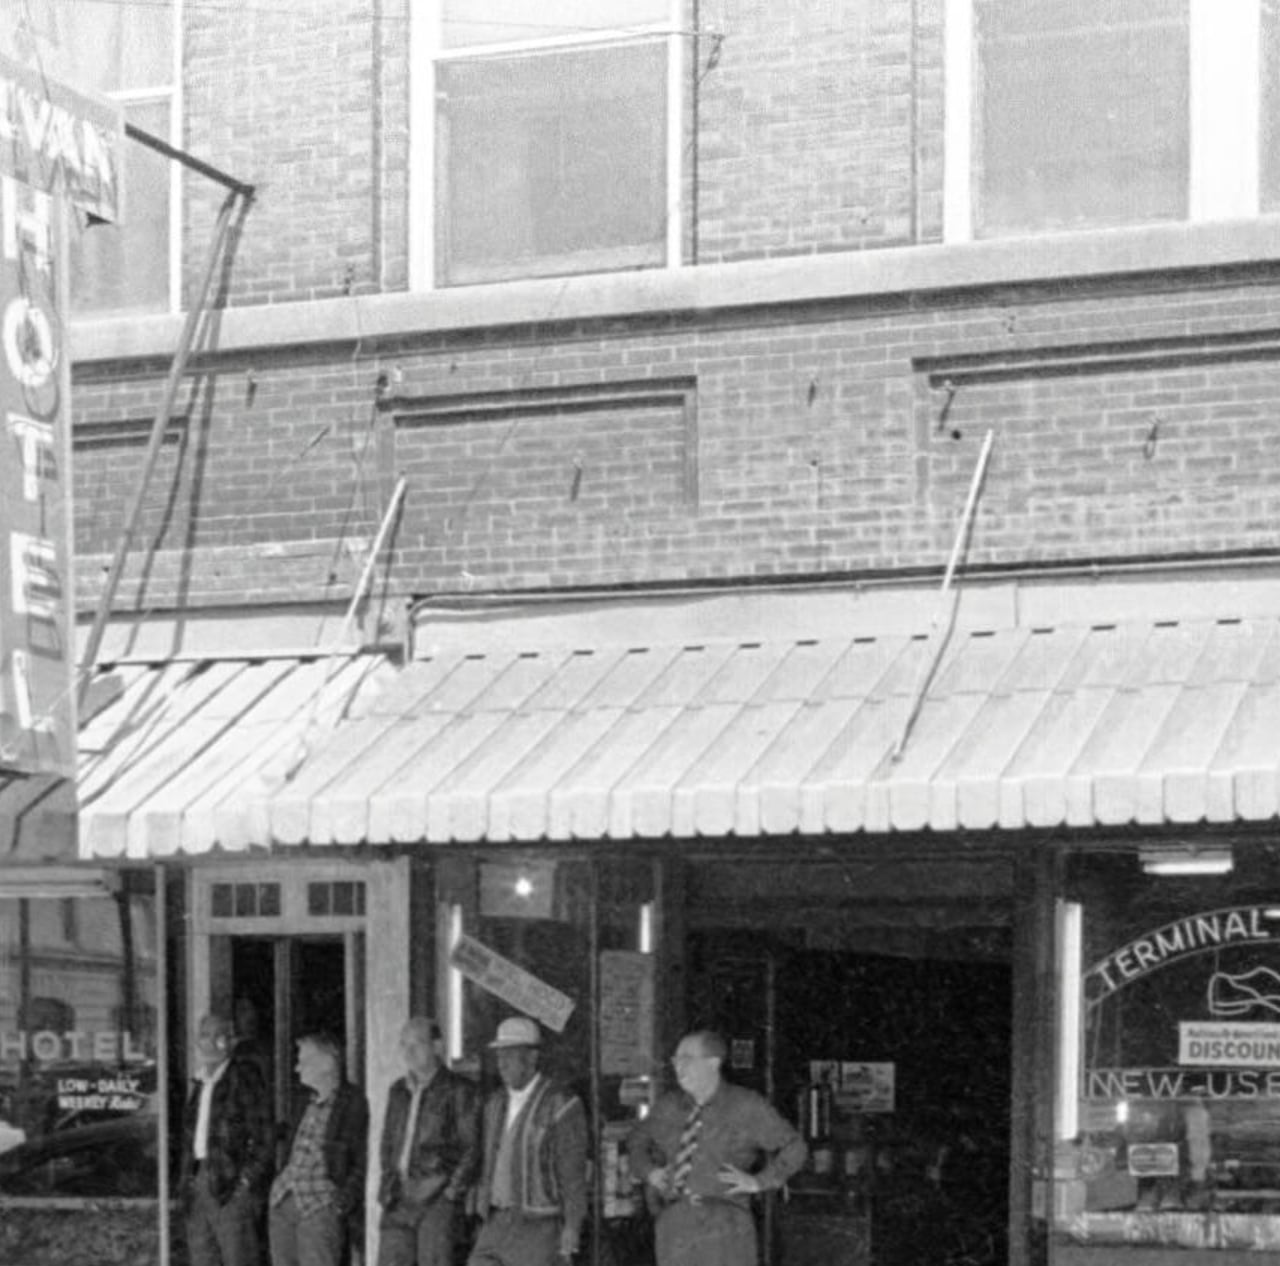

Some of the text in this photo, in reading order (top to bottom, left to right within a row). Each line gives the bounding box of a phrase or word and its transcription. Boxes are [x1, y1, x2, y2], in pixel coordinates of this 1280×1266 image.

[0, 174, 58, 732] HOTEL
[1096, 908, 1270, 992] TERMINAL
[0, 1031, 148, 1062] HOTEL
